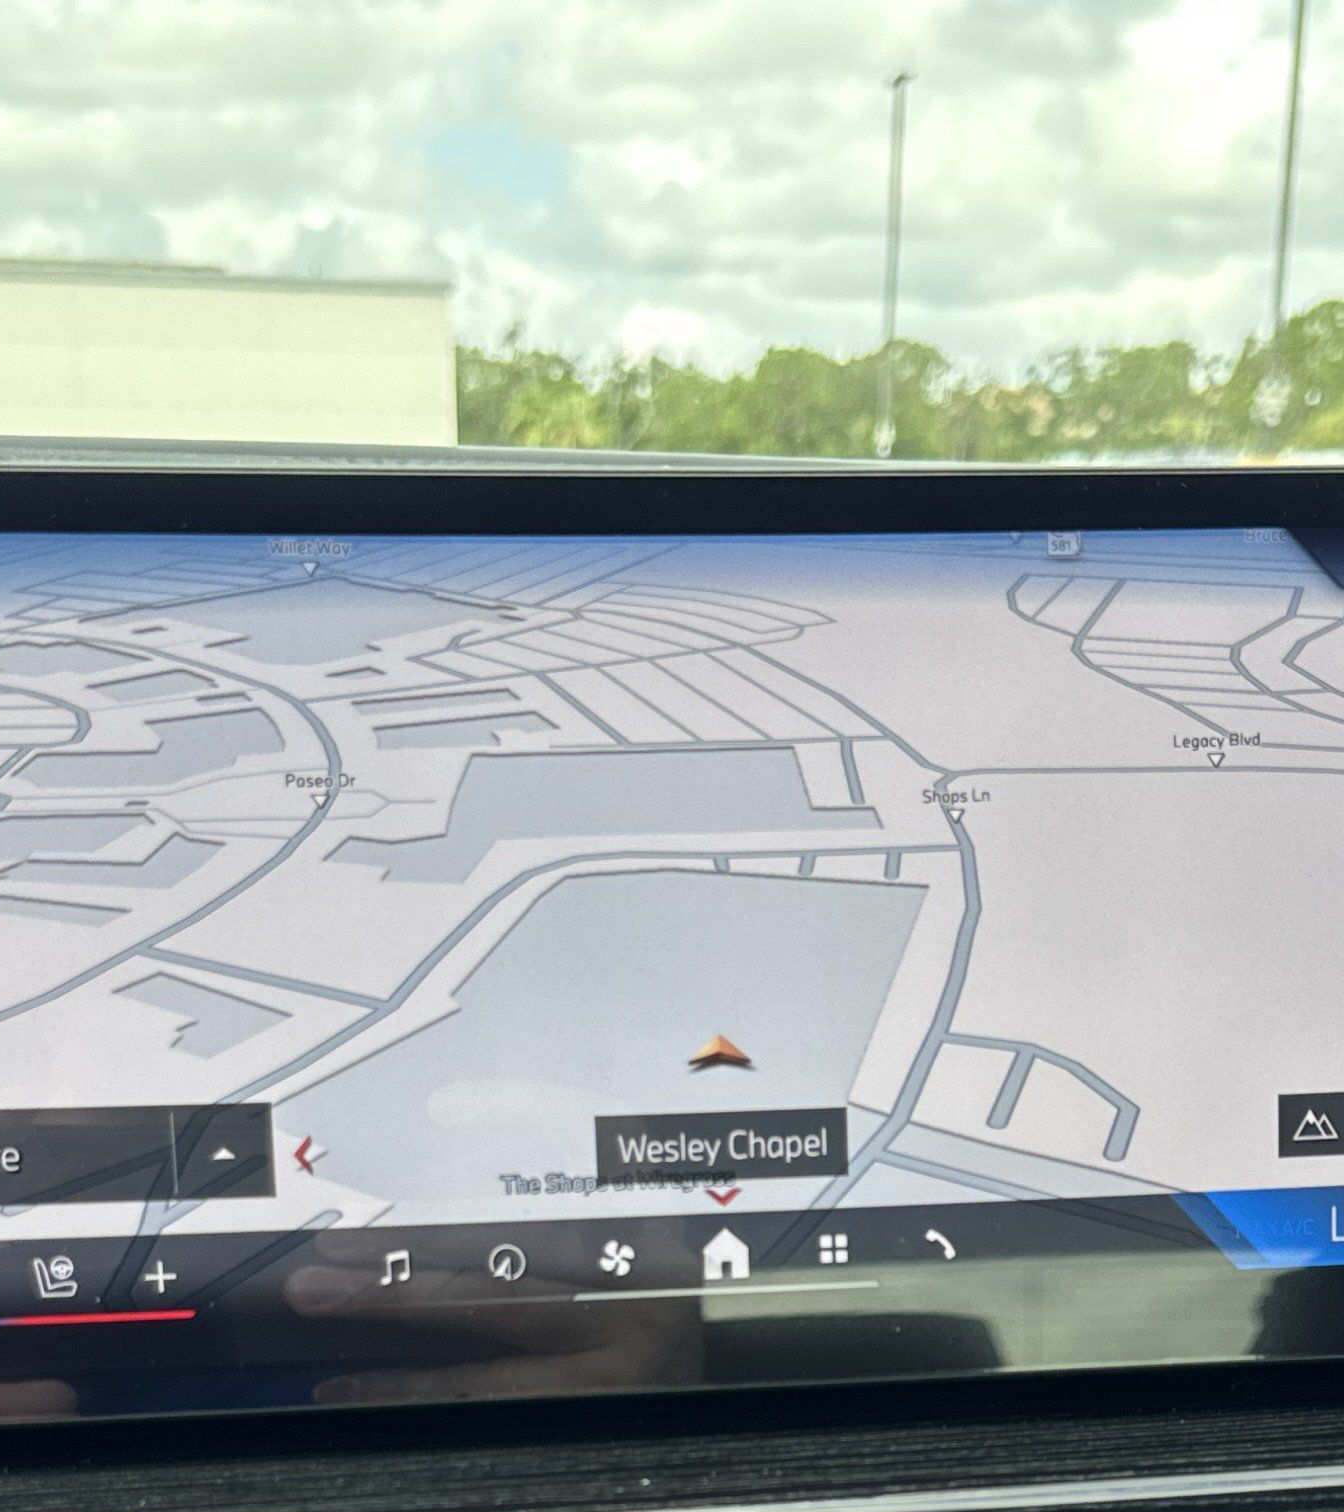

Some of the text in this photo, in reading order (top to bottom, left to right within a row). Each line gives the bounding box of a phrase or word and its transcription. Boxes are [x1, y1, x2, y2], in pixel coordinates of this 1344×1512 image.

[269, 541, 351, 560] Willet Way
[1173, 732, 1261, 752] Legacy Blvd
[285, 773, 357, 789] Paseo Dr
[922, 788, 991, 805] Shops Ln
[617, 1126, 828, 1167] Wesley Chapel
[500, 1173, 541, 1196] The
